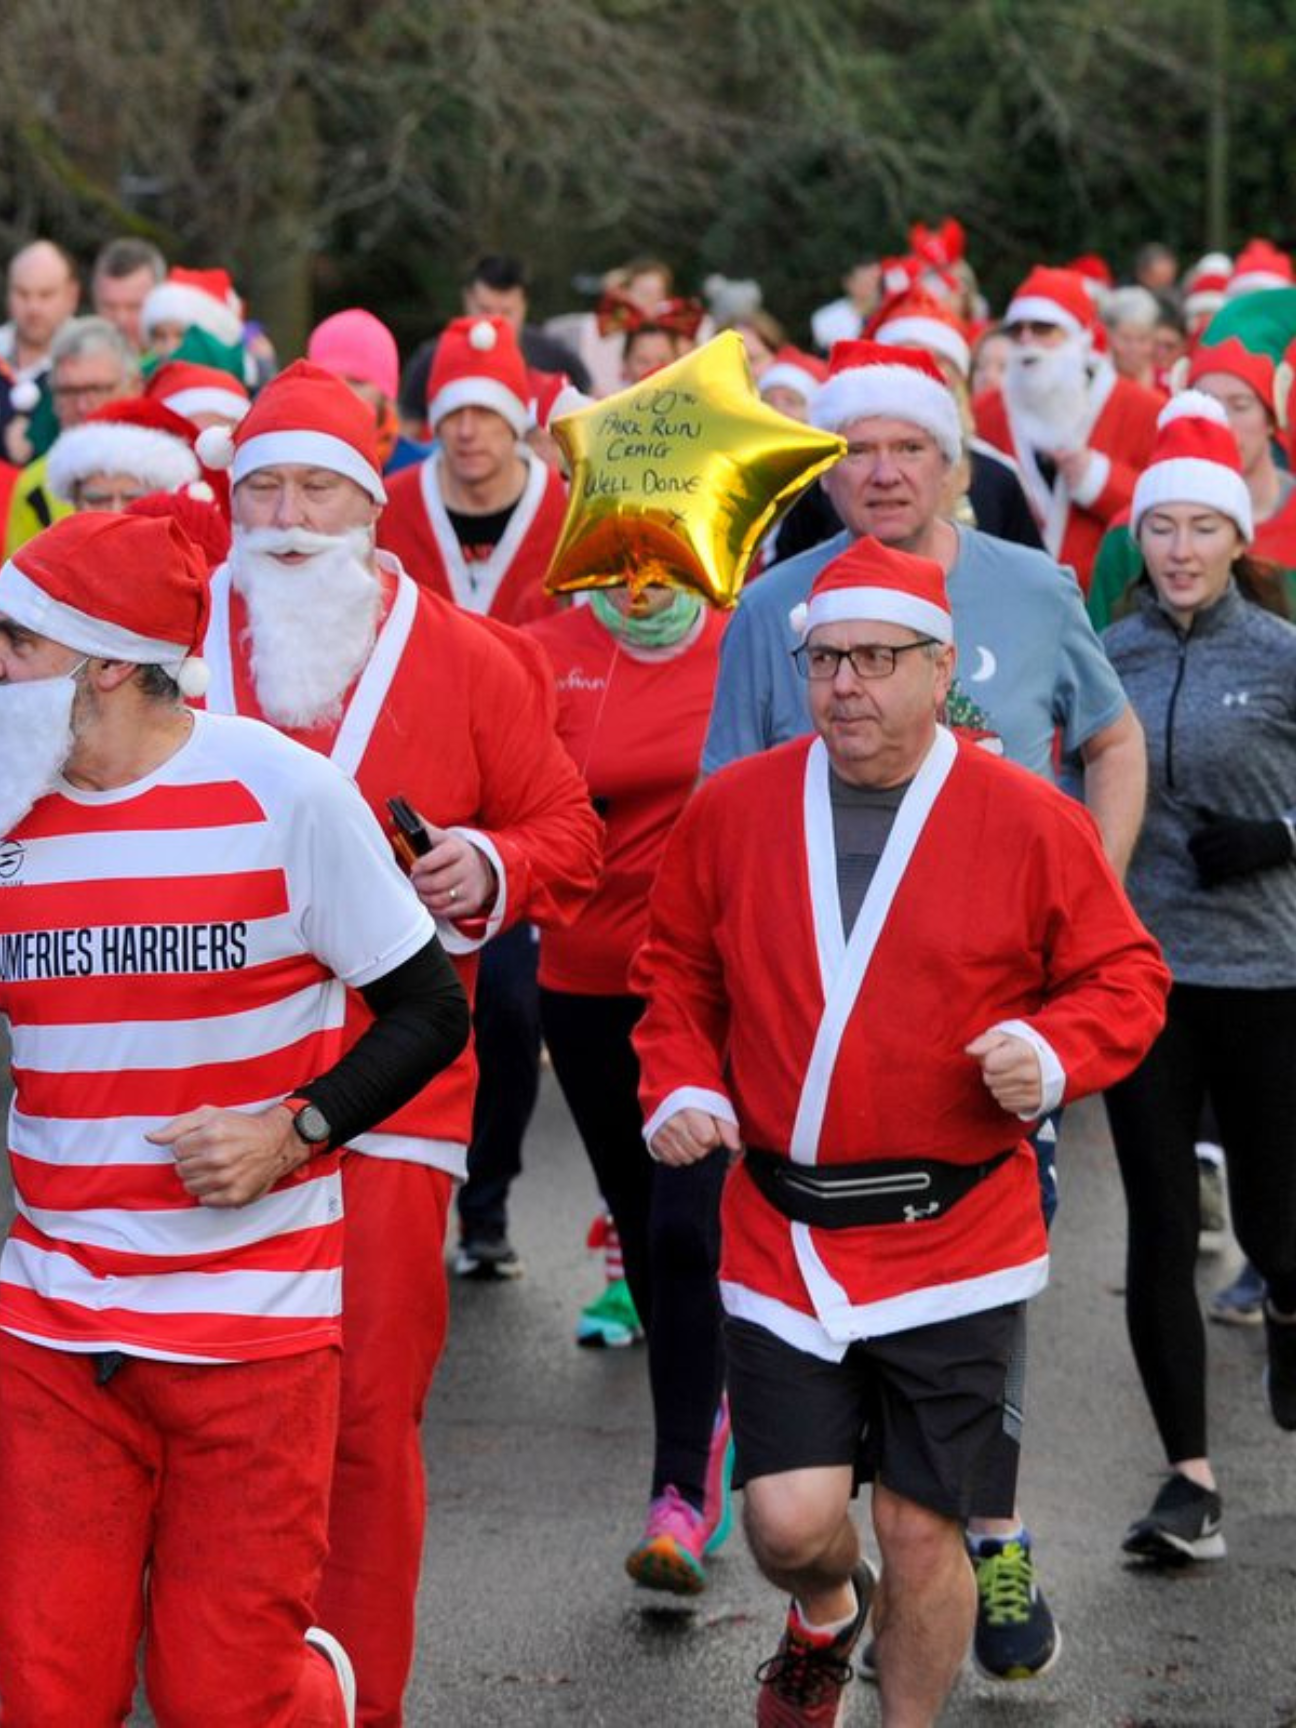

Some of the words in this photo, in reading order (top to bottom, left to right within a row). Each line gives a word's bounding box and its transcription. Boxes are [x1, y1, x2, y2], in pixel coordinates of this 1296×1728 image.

[597, 411, 642, 435] PARK
[650, 416, 702, 439] RUN
[606, 438, 672, 462] CRAIG
[583, 469, 632, 499] WELL
[642, 468, 702, 496] DONE
[101, 921, 247, 974] HARRIERS
